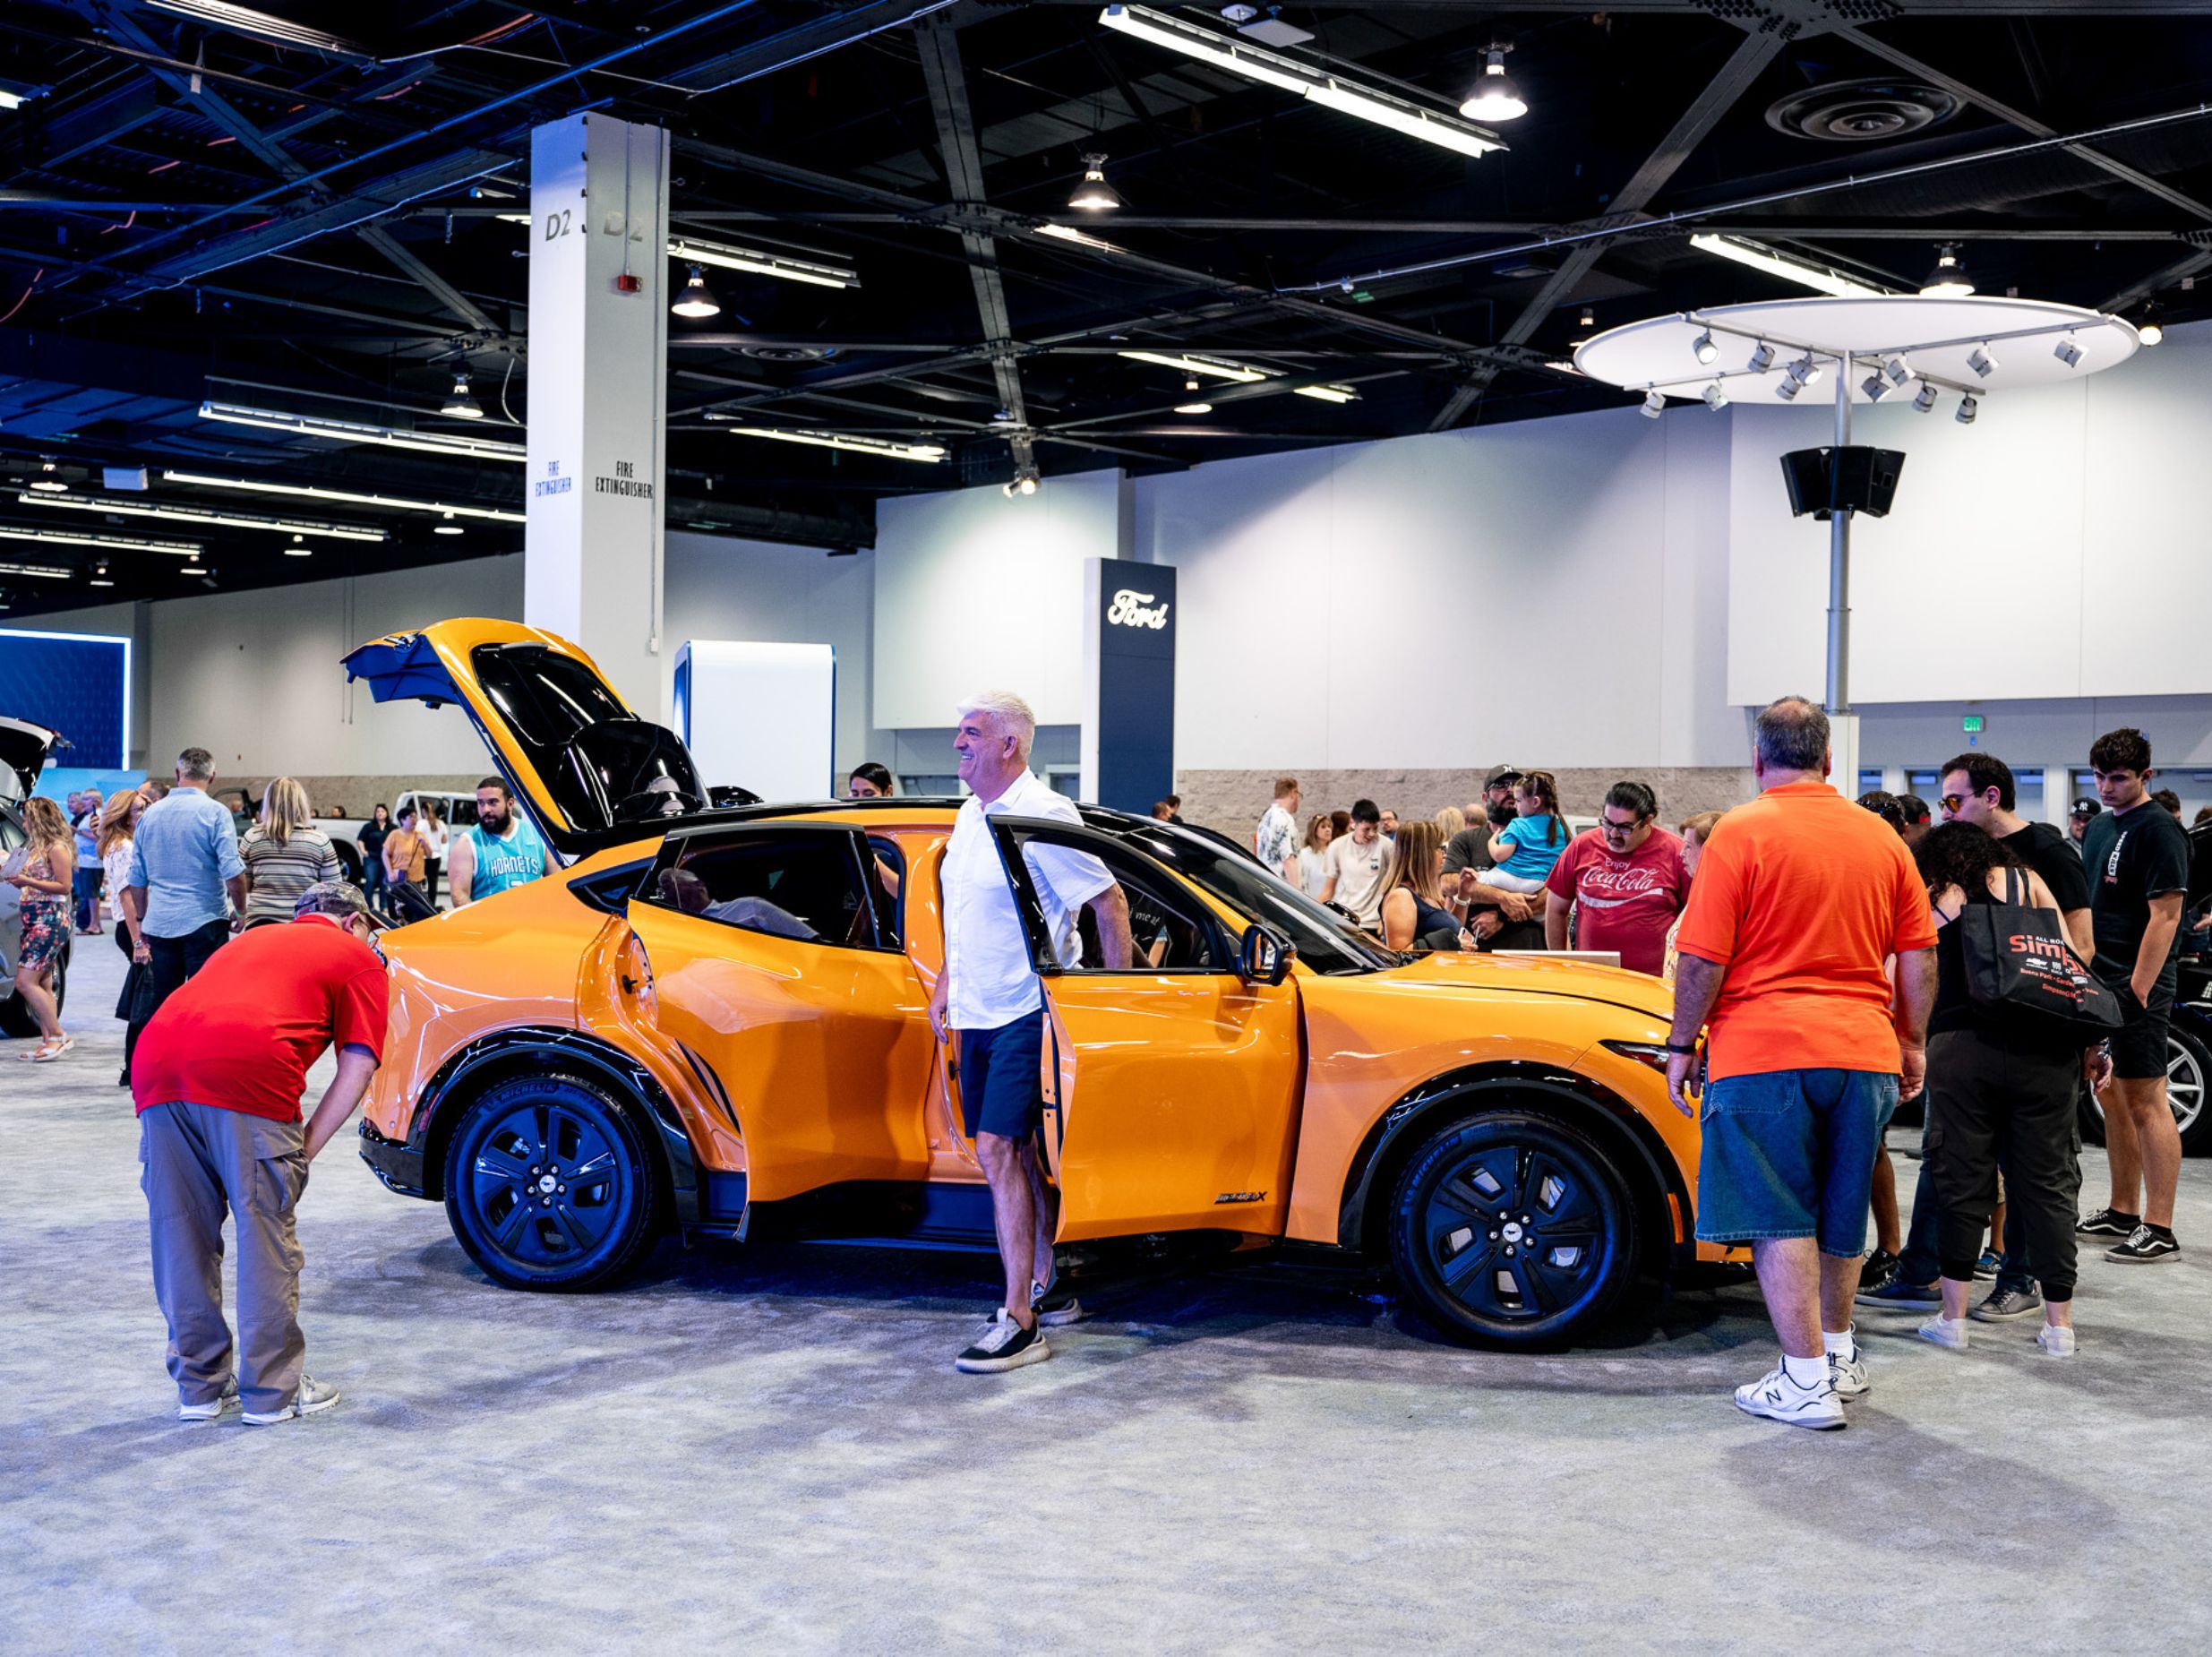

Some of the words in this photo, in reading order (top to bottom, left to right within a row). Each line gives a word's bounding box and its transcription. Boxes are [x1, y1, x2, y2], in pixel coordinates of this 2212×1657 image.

[545, 209, 571, 242] D2
[548, 460, 560, 476] FIRE
[617, 460, 634, 478] FIRE
[536, 476, 571, 497] EXTINGUISHER
[596, 476, 653, 499] EXTINGUISHER
[1107, 589, 1169, 630] Ford
[491, 855, 538, 878] HORNETS
[1605, 857, 1632, 870] Enjoy
